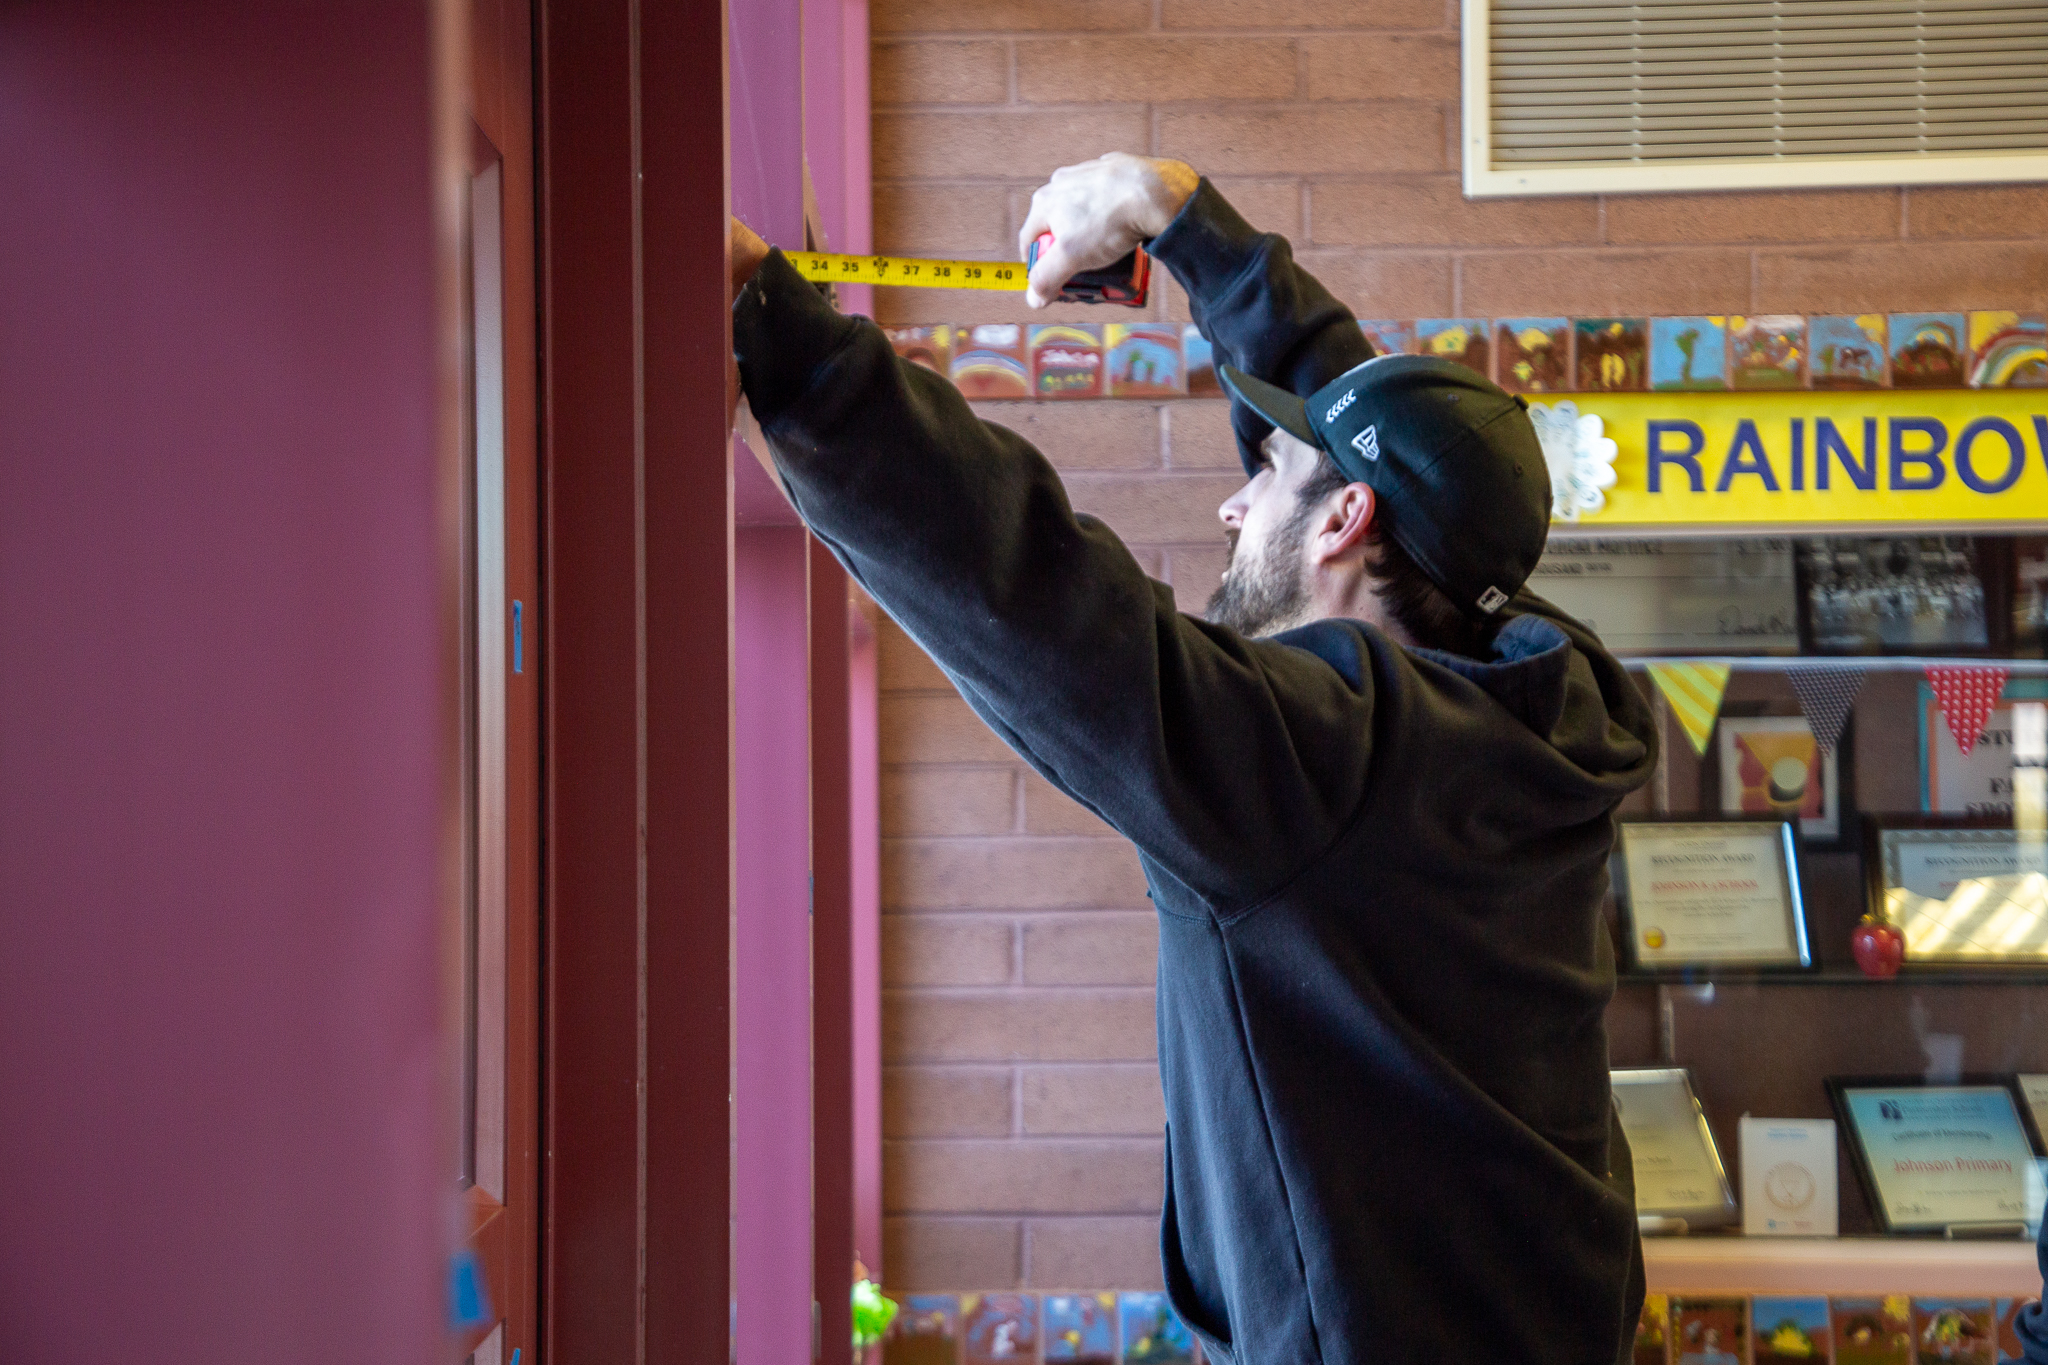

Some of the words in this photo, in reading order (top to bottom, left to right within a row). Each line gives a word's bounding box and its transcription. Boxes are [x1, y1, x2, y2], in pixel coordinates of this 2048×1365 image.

[811, 259, 829, 271] 34
[842, 261, 859, 272] 35
[903, 265, 920, 276] 37
[934, 266, 951, 277] 38
[964, 268, 982, 279] 39
[995, 269, 1013, 280] 40
[1646, 415, 2048, 495] RAINBO
[1894, 1158, 1954, 1174] Johnson
[1955, 1156, 2012, 1174] Primary
